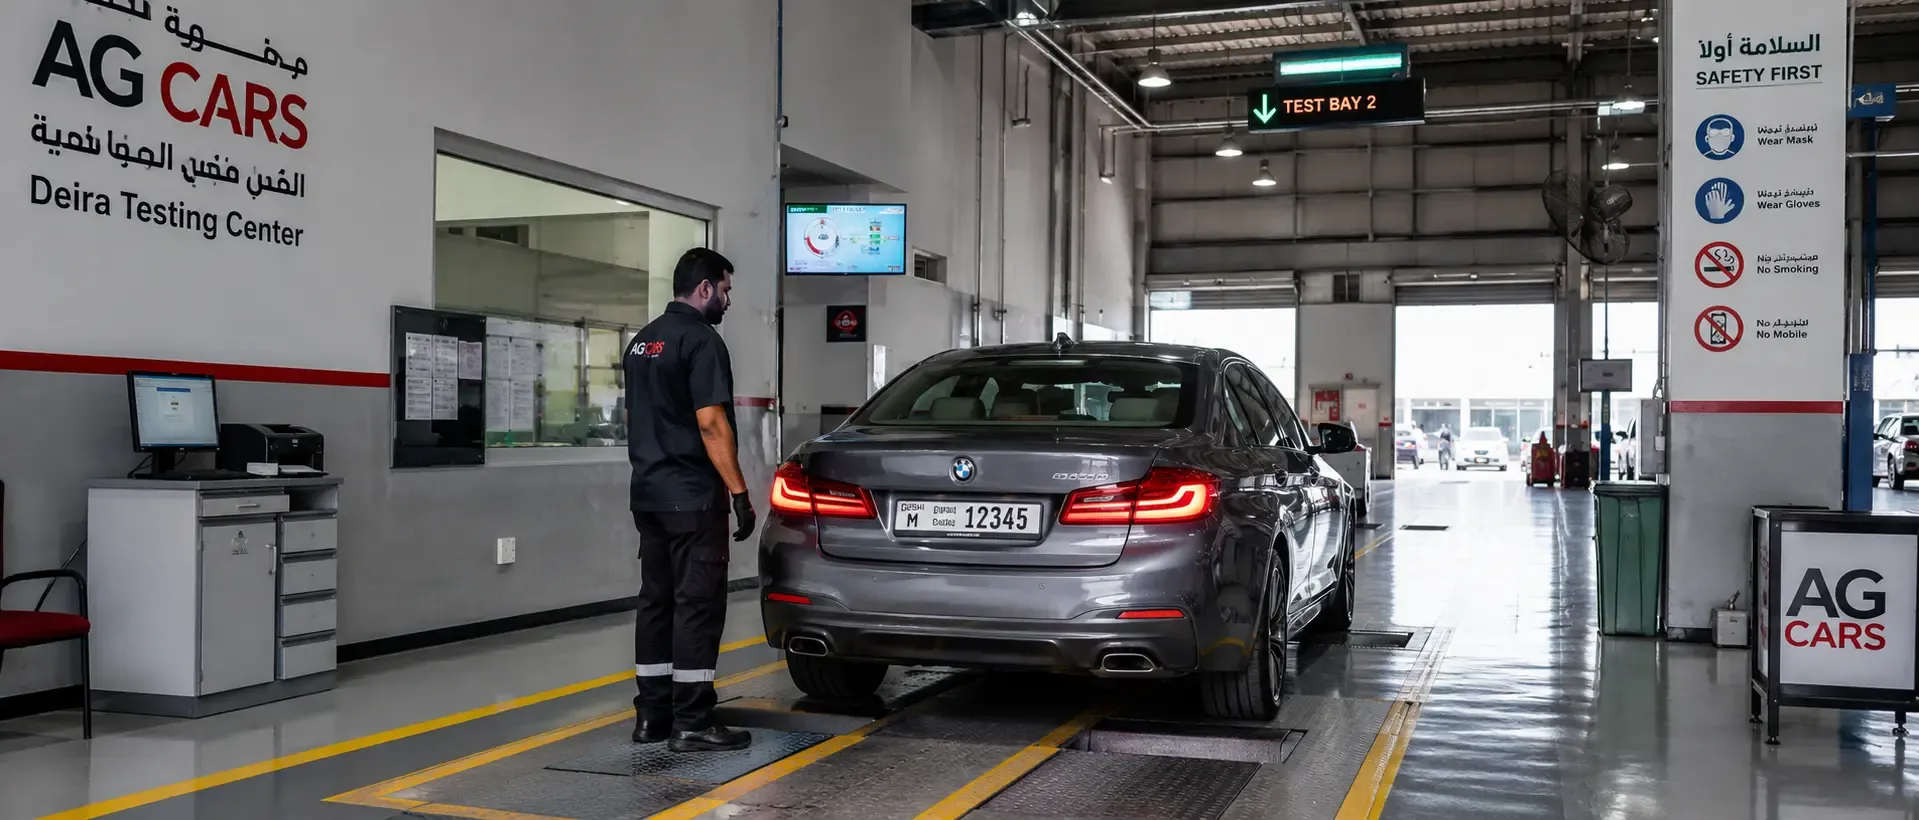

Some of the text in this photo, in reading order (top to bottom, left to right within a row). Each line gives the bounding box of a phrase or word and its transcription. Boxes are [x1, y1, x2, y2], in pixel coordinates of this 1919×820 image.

[1740, 33, 1820, 56] السلامة
[31, 19, 308, 150] AG CARS
[1696, 65, 1822, 86] SAFETY FIRST
[1283, 95, 1376, 114] TEST BAY 2
[1757, 135, 1813, 146] Wear Mask
[31, 174, 304, 247] Deira Testing Center
[1757, 199, 1821, 209] Wear Gloves
[1757, 264, 1819, 275] No Smoking
[1756, 330, 1808, 339] No Mobile
[630, 342, 646, 355] AG
[906, 513, 918, 527] M
[965, 505, 1028, 530] 12345
[1785, 568, 1886, 620] AG
[1784, 620, 1886, 651] CARS
